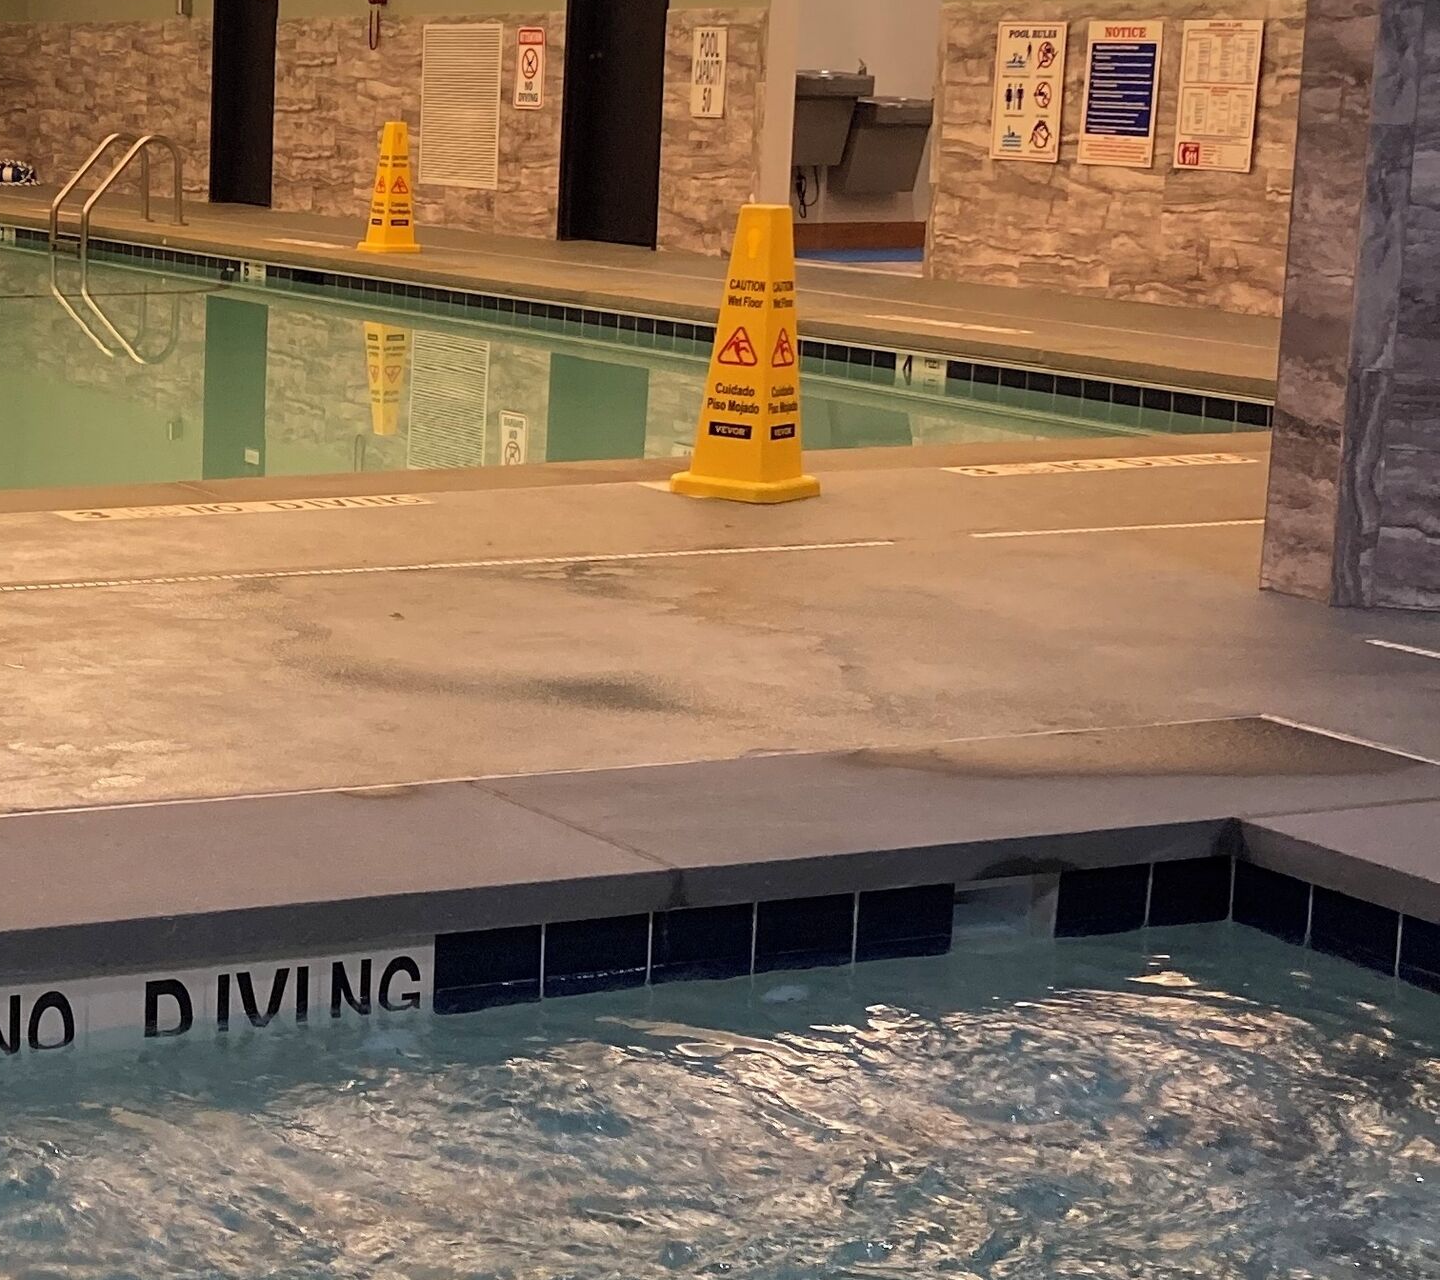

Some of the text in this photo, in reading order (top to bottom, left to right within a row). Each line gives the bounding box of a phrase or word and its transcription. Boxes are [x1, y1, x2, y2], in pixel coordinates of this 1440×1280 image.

[1008, 29, 1058, 39] POOL RULES
[1104, 26, 1147, 39] NOTICE
[700, 32, 719, 58] POOL
[524, 81, 534, 91] NO
[518, 92, 539, 102] DIVING
[702, 87, 712, 113] 50
[729, 278, 766, 292] CAUTION
[772, 280, 794, 293] CAUTION
[728, 294, 764, 308] Wet Floor
[715, 382, 756, 398] Cuidado
[771, 384, 795, 398] Cuidado
[707, 397, 760, 416] Piso Mojado
[714, 425, 747, 436] VEVOR
[74, 511, 111, 519] 3
[185, 504, 243, 514] NO
[266, 494, 424, 511] DIVING
[143, 954, 422, 1039] DIVING
